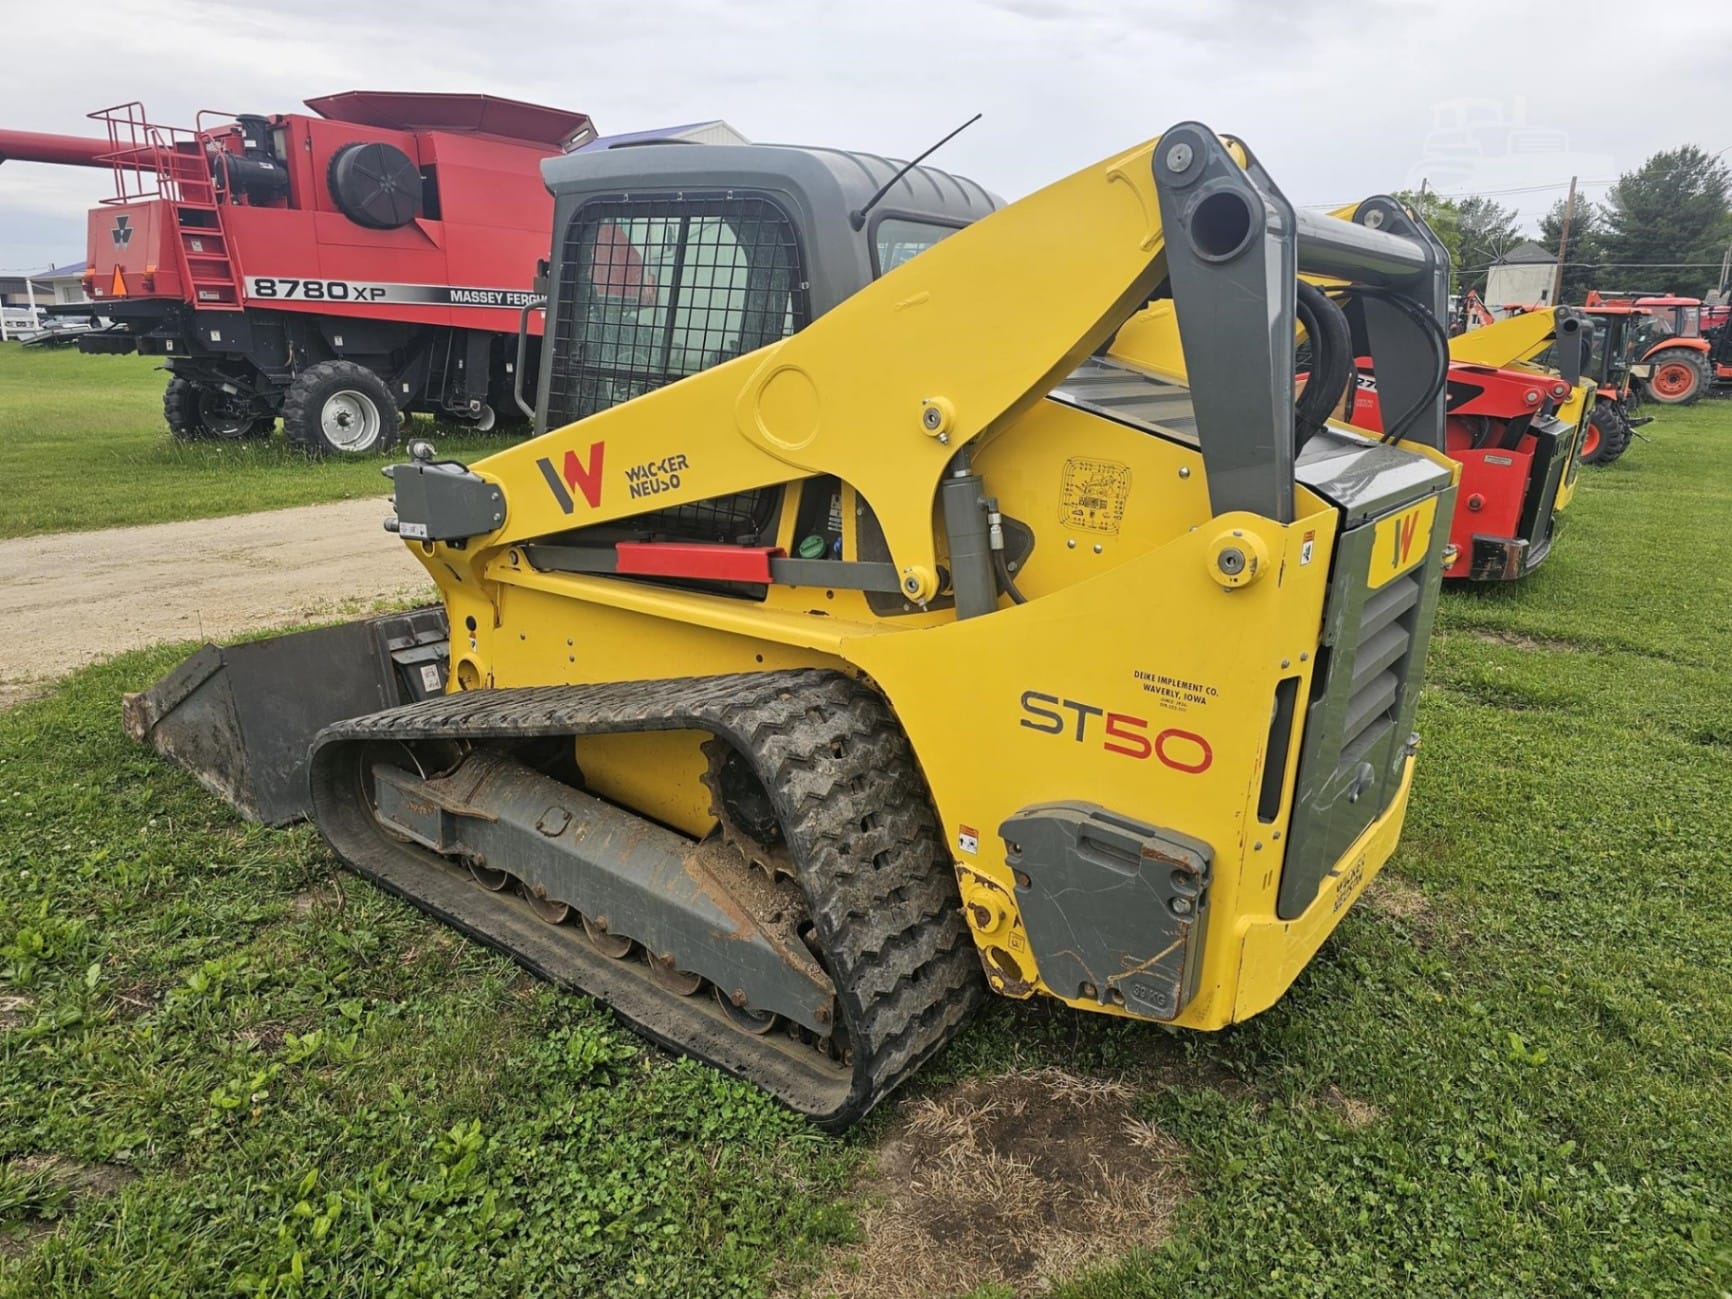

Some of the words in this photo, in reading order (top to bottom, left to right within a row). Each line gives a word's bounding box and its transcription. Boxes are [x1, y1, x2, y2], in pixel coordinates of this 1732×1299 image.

[254, 278, 349, 300] 8780
[353, 286, 386, 301] XP
[450, 290, 503, 304] MASSEY
[625, 454, 690, 483] WACKER
[1134, 670, 1156, 682] DEIKE
[1157, 675, 1203, 693] IMPLEMENT
[1205, 686, 1219, 697] CO.
[1143, 683, 1182, 700] WAVERLY,
[1184, 693, 1207, 705] IOWA
[1020, 690, 1213, 774] ST50
